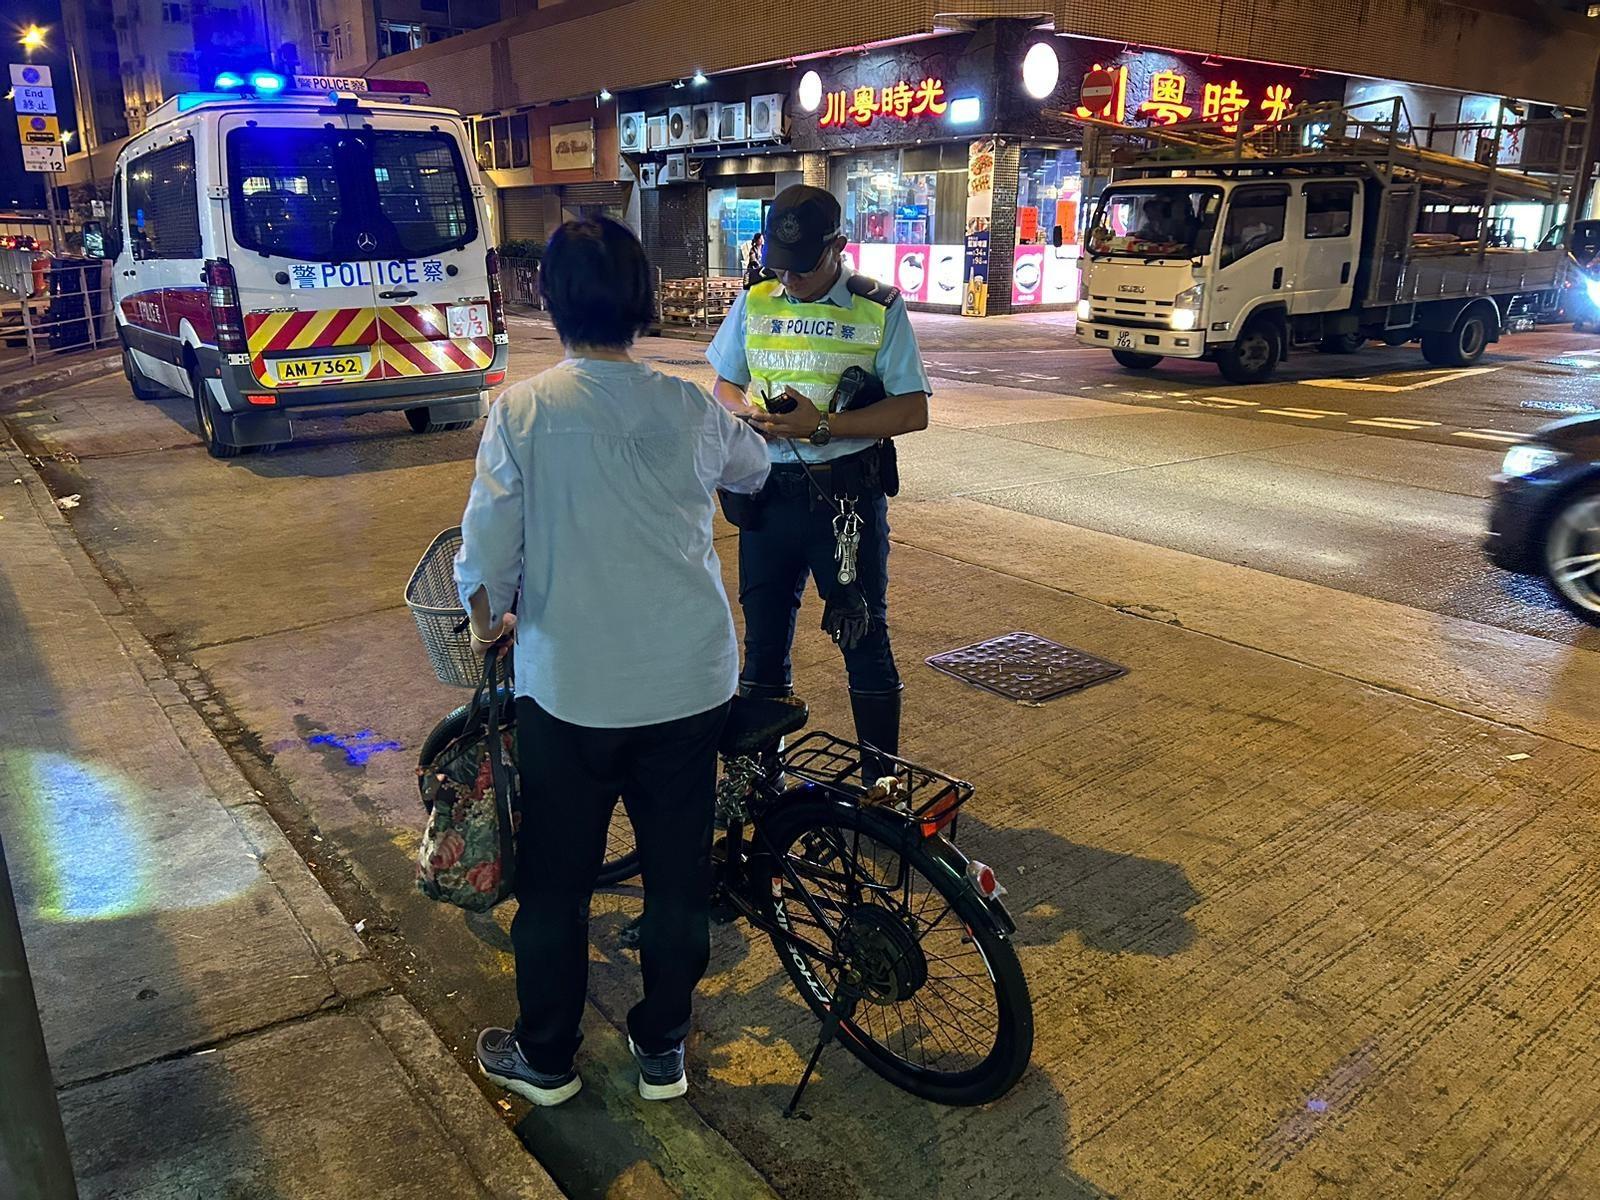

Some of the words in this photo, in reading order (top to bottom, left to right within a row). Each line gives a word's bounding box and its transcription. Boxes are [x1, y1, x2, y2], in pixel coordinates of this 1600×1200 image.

[313, 77, 350, 90] POLICE
[24, 89, 44, 98] End
[47, 148, 54, 156] 7
[49, 161, 63, 171] 12
[292, 265, 317, 289] 警
[321, 260, 419, 288] POLICE
[422, 259, 444, 283] 察
[1118, 284, 1146, 294] ISUZU
[787, 319, 835, 337] POLICE
[841, 325, 856, 340] 察
[1119, 330, 1130, 339] UP
[1117, 338, 1131, 347] 762
[285, 363, 308, 378] AM
[311, 359, 358, 376] 7362
